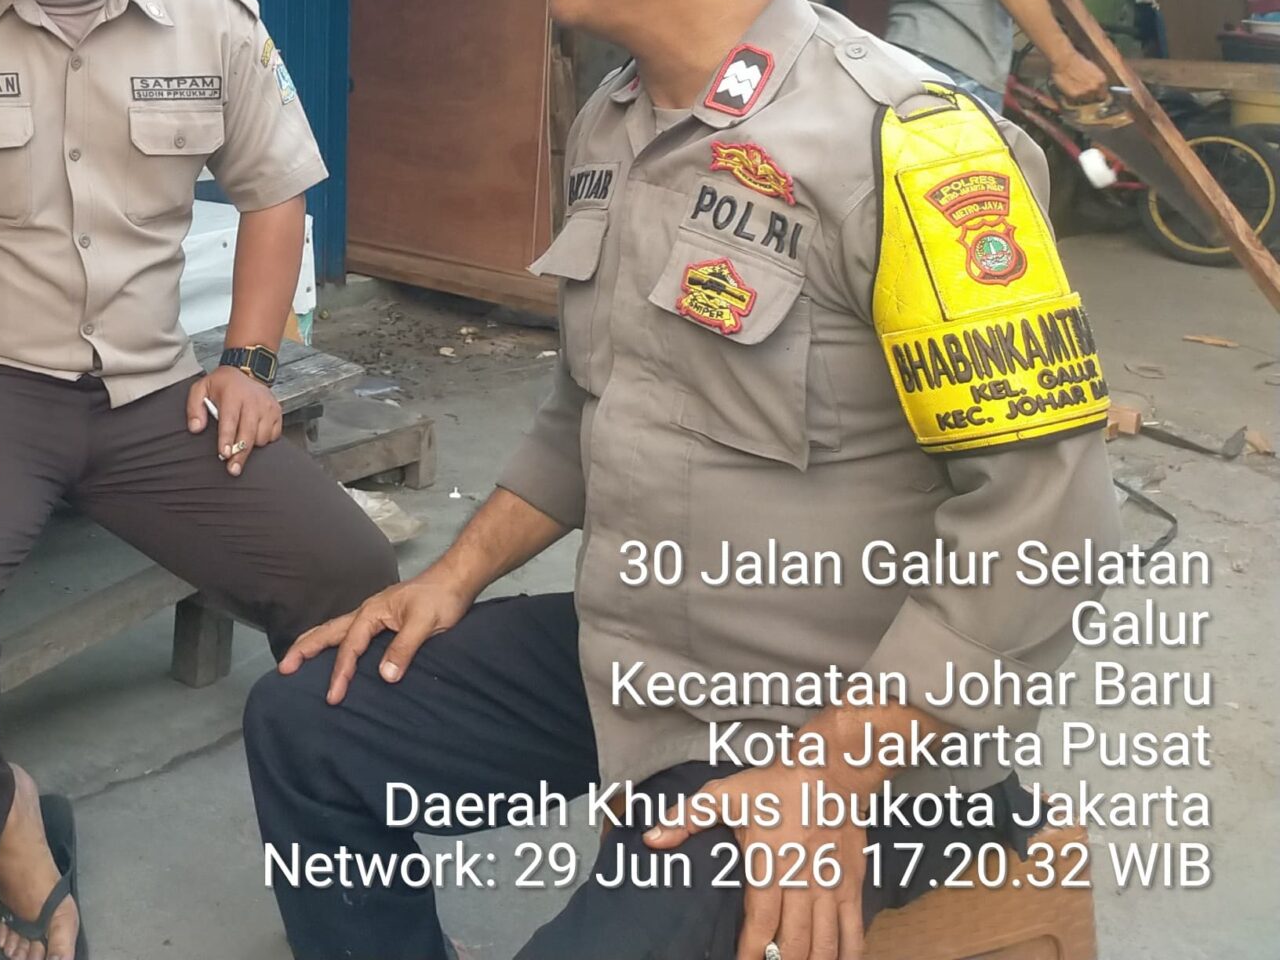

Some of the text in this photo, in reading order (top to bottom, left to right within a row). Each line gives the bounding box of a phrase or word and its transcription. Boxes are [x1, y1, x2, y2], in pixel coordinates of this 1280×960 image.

[6, 77, 16, 93] N
[140, 77, 215, 89] SATPAM
[136, 90, 164, 98] SUDIN
[167, 90, 206, 98] PPKUKM
[940, 175, 997, 197] POLRES
[690, 184, 804, 260] POLRI
[688, 299, 725, 320] SNIPER
[970, 380, 1027, 404] KEL.
[935, 406, 995, 431] KEC.
[1005, 388, 1087, 420] JOHAR
